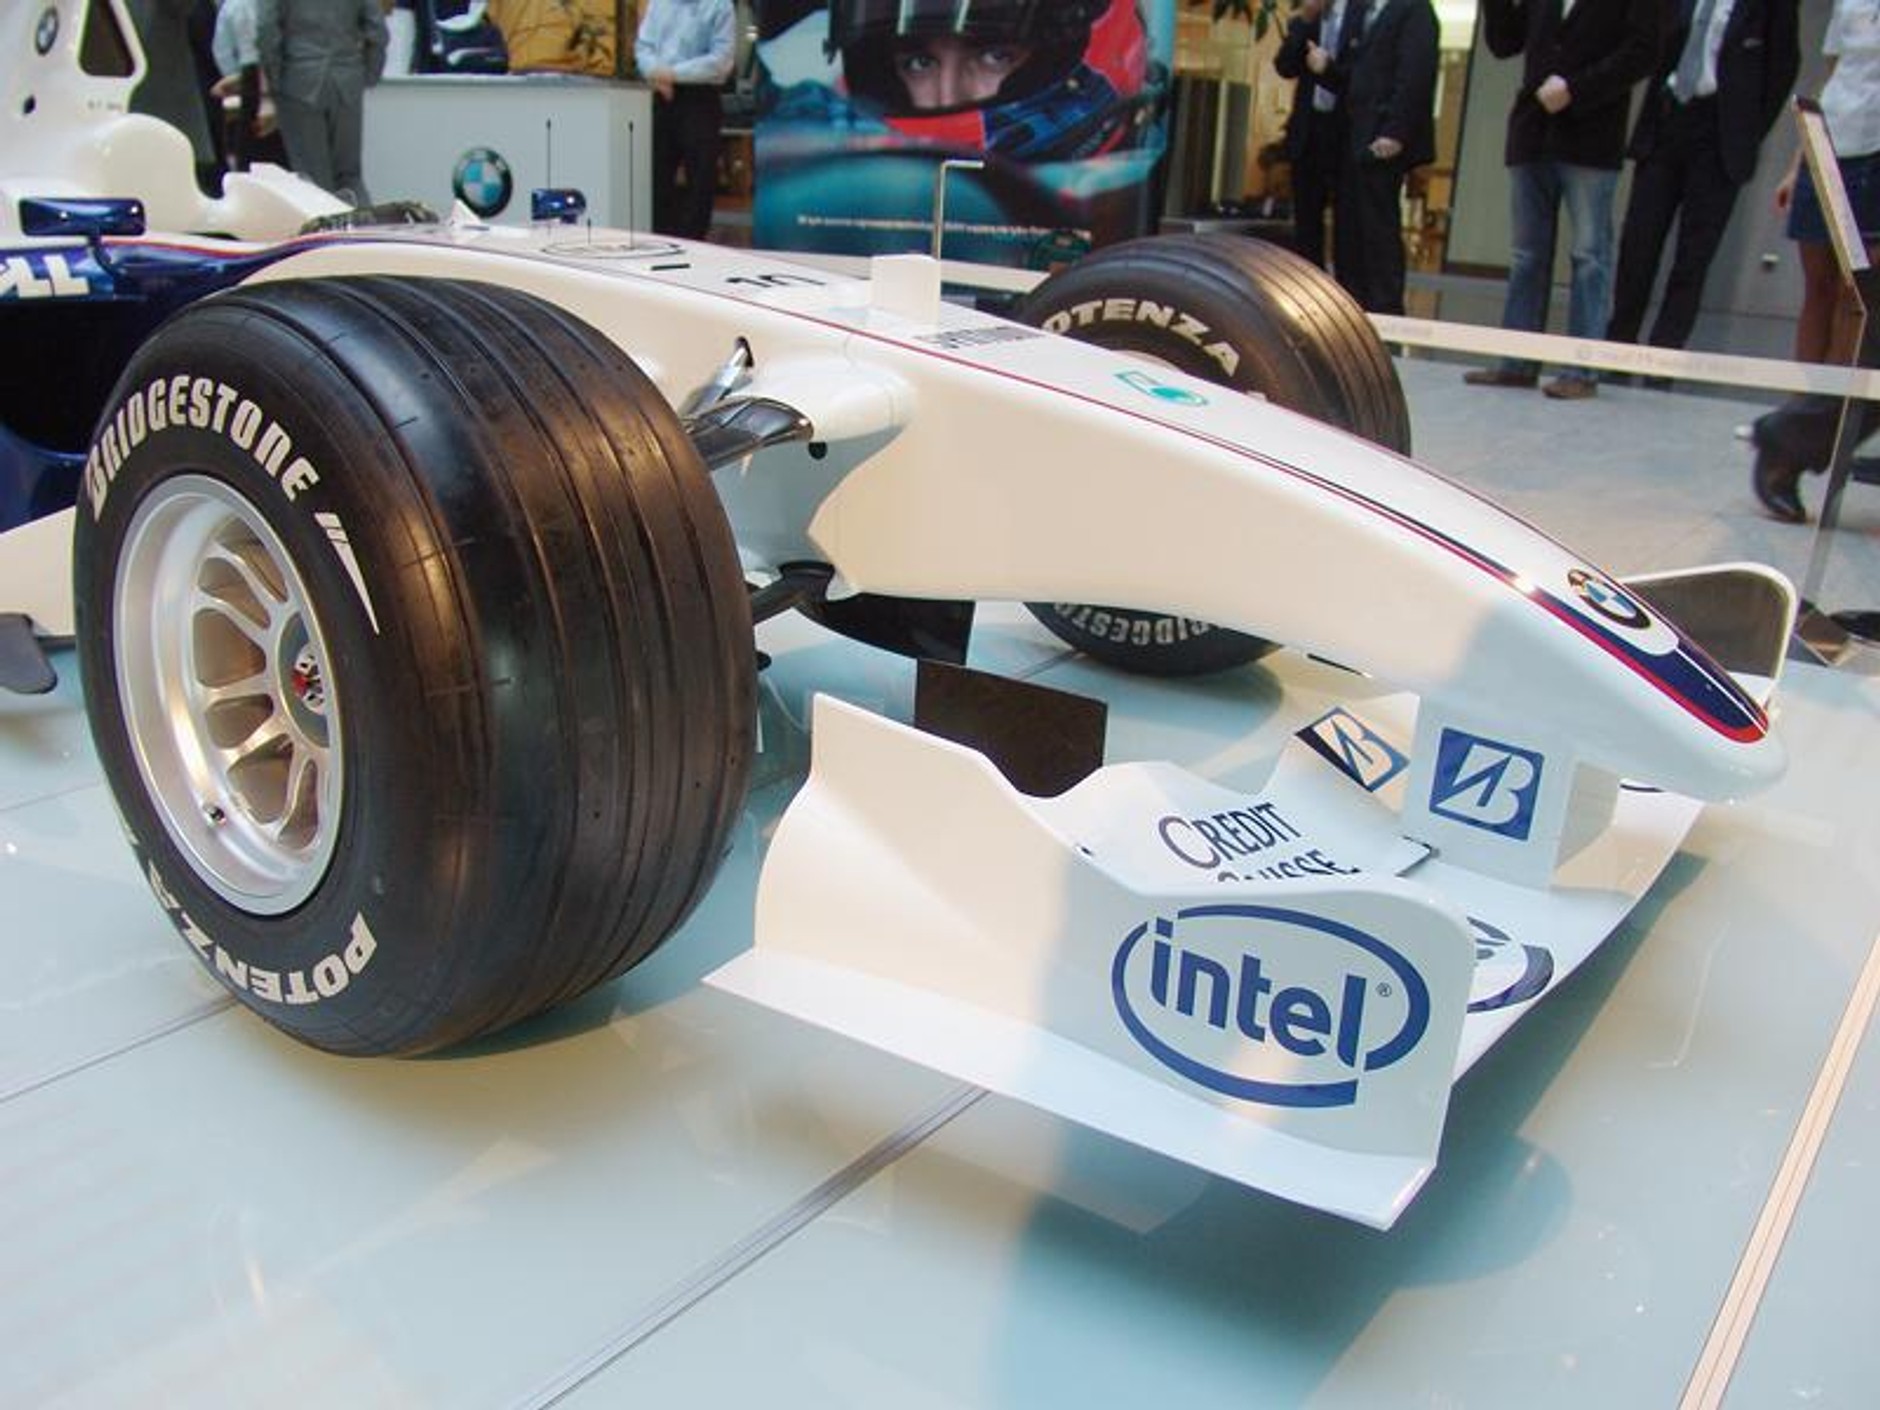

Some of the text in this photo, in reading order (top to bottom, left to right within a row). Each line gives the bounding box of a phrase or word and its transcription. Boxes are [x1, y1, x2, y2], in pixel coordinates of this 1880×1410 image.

[0, 254, 90, 298] LL
[84, 375, 320, 522] BRIDGESTONE
[1158, 802, 1301, 868] CREDIT
